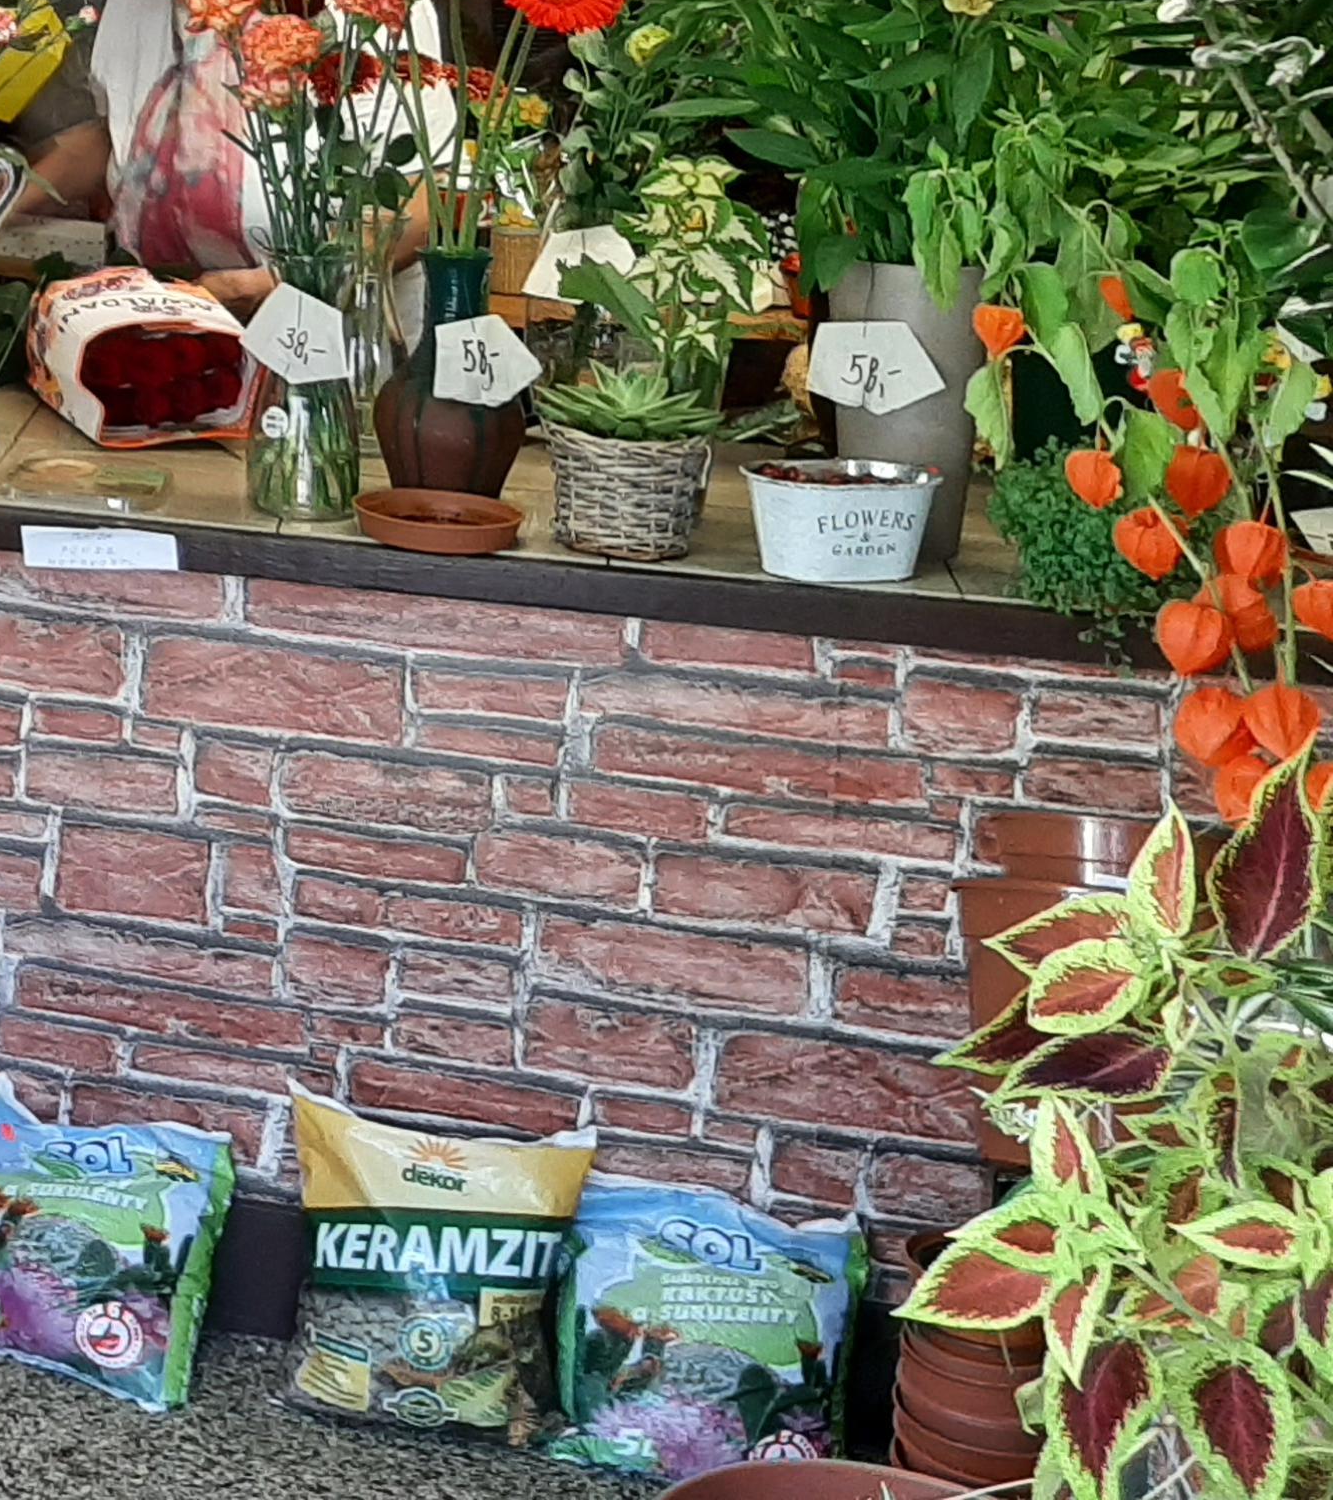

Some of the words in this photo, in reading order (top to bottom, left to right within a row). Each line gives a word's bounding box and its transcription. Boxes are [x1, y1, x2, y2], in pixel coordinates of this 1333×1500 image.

[817, 508, 917, 534] FLOWERS
[831, 543, 897, 557] GARDEN
[44, 1135, 134, 1175] SOL
[401, 1163, 467, 1193] dekor
[314, 1221, 563, 1279] KERAMZIT
[659, 1217, 763, 1272] SOL
[417, 1329, 434, 1351] 5
